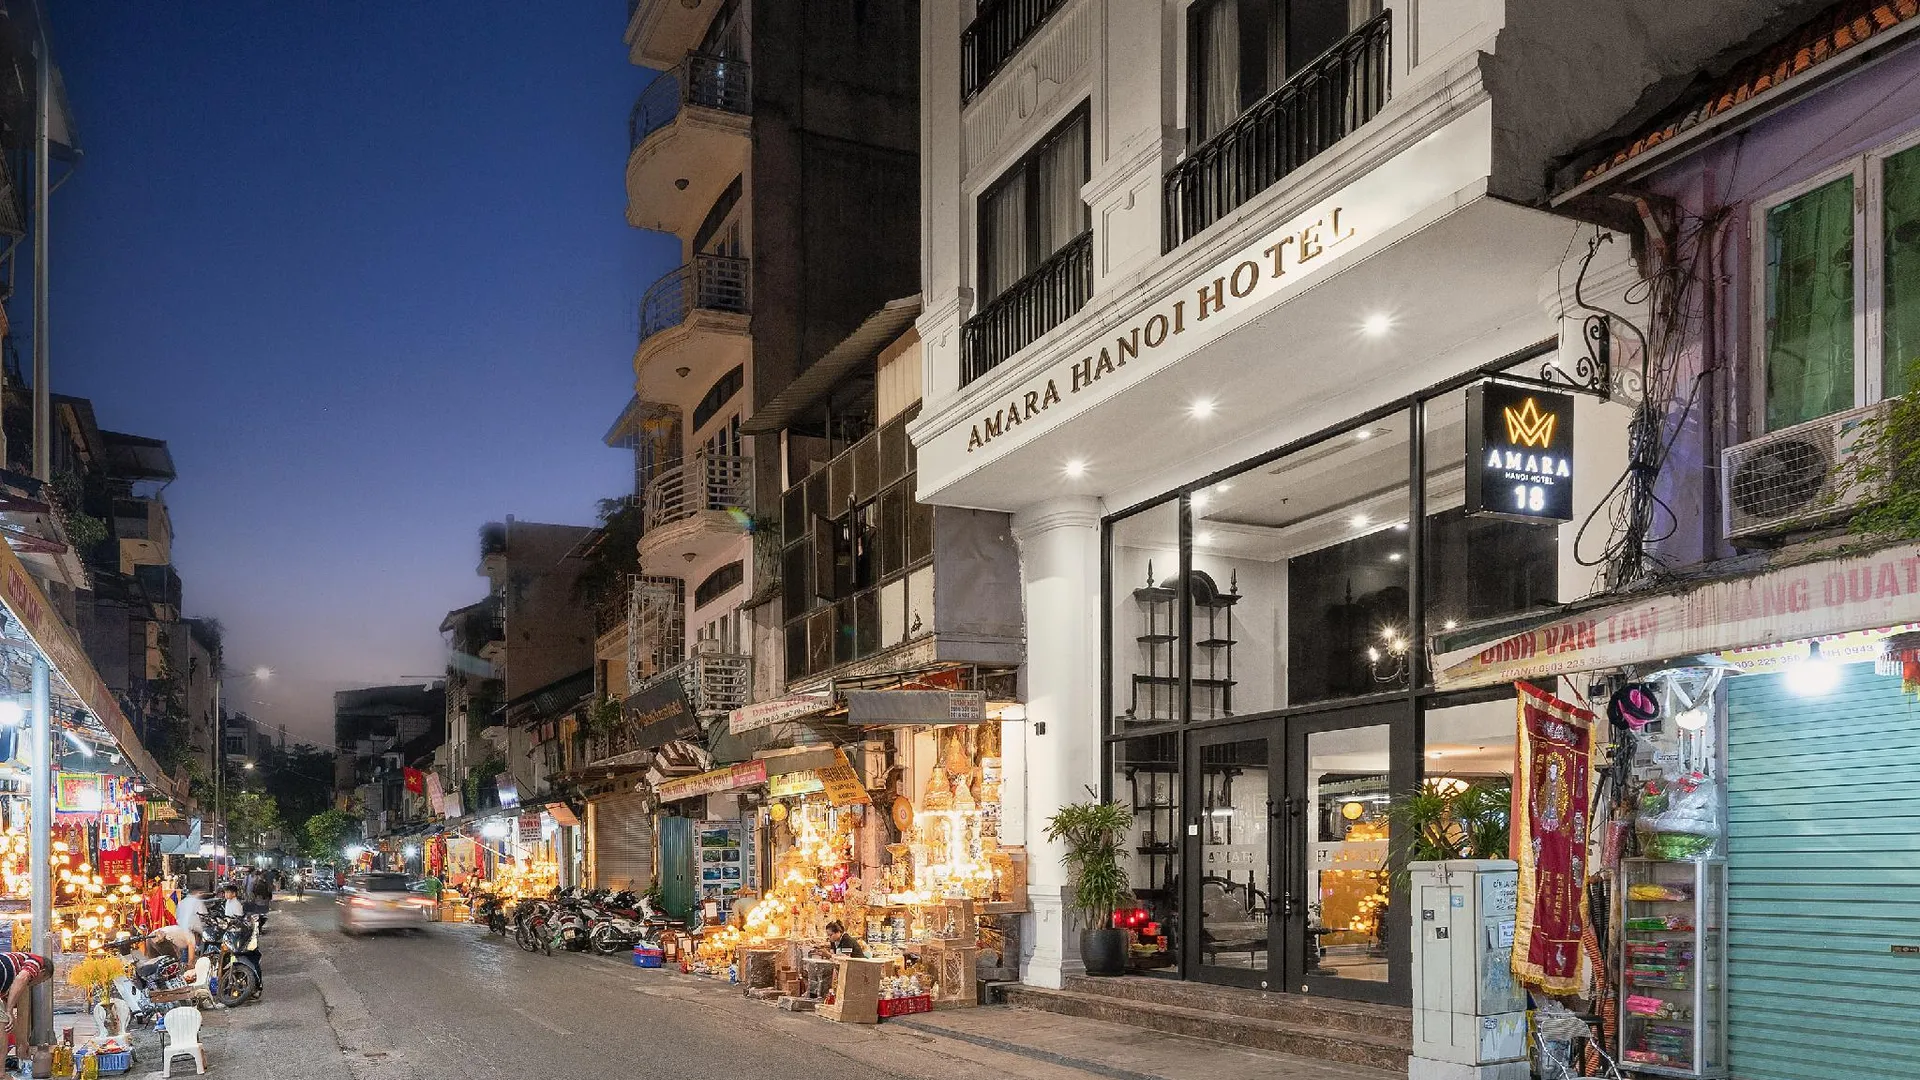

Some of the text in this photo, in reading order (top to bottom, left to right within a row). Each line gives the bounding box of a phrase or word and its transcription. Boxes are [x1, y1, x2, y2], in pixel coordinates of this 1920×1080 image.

[966, 207, 1355, 453] AMARA HANOI HOTEL
[1487, 449, 1570, 477] AMARA
[1505, 471, 1554, 485] HANOI HOTEL
[1514, 484, 1545, 512] 18
